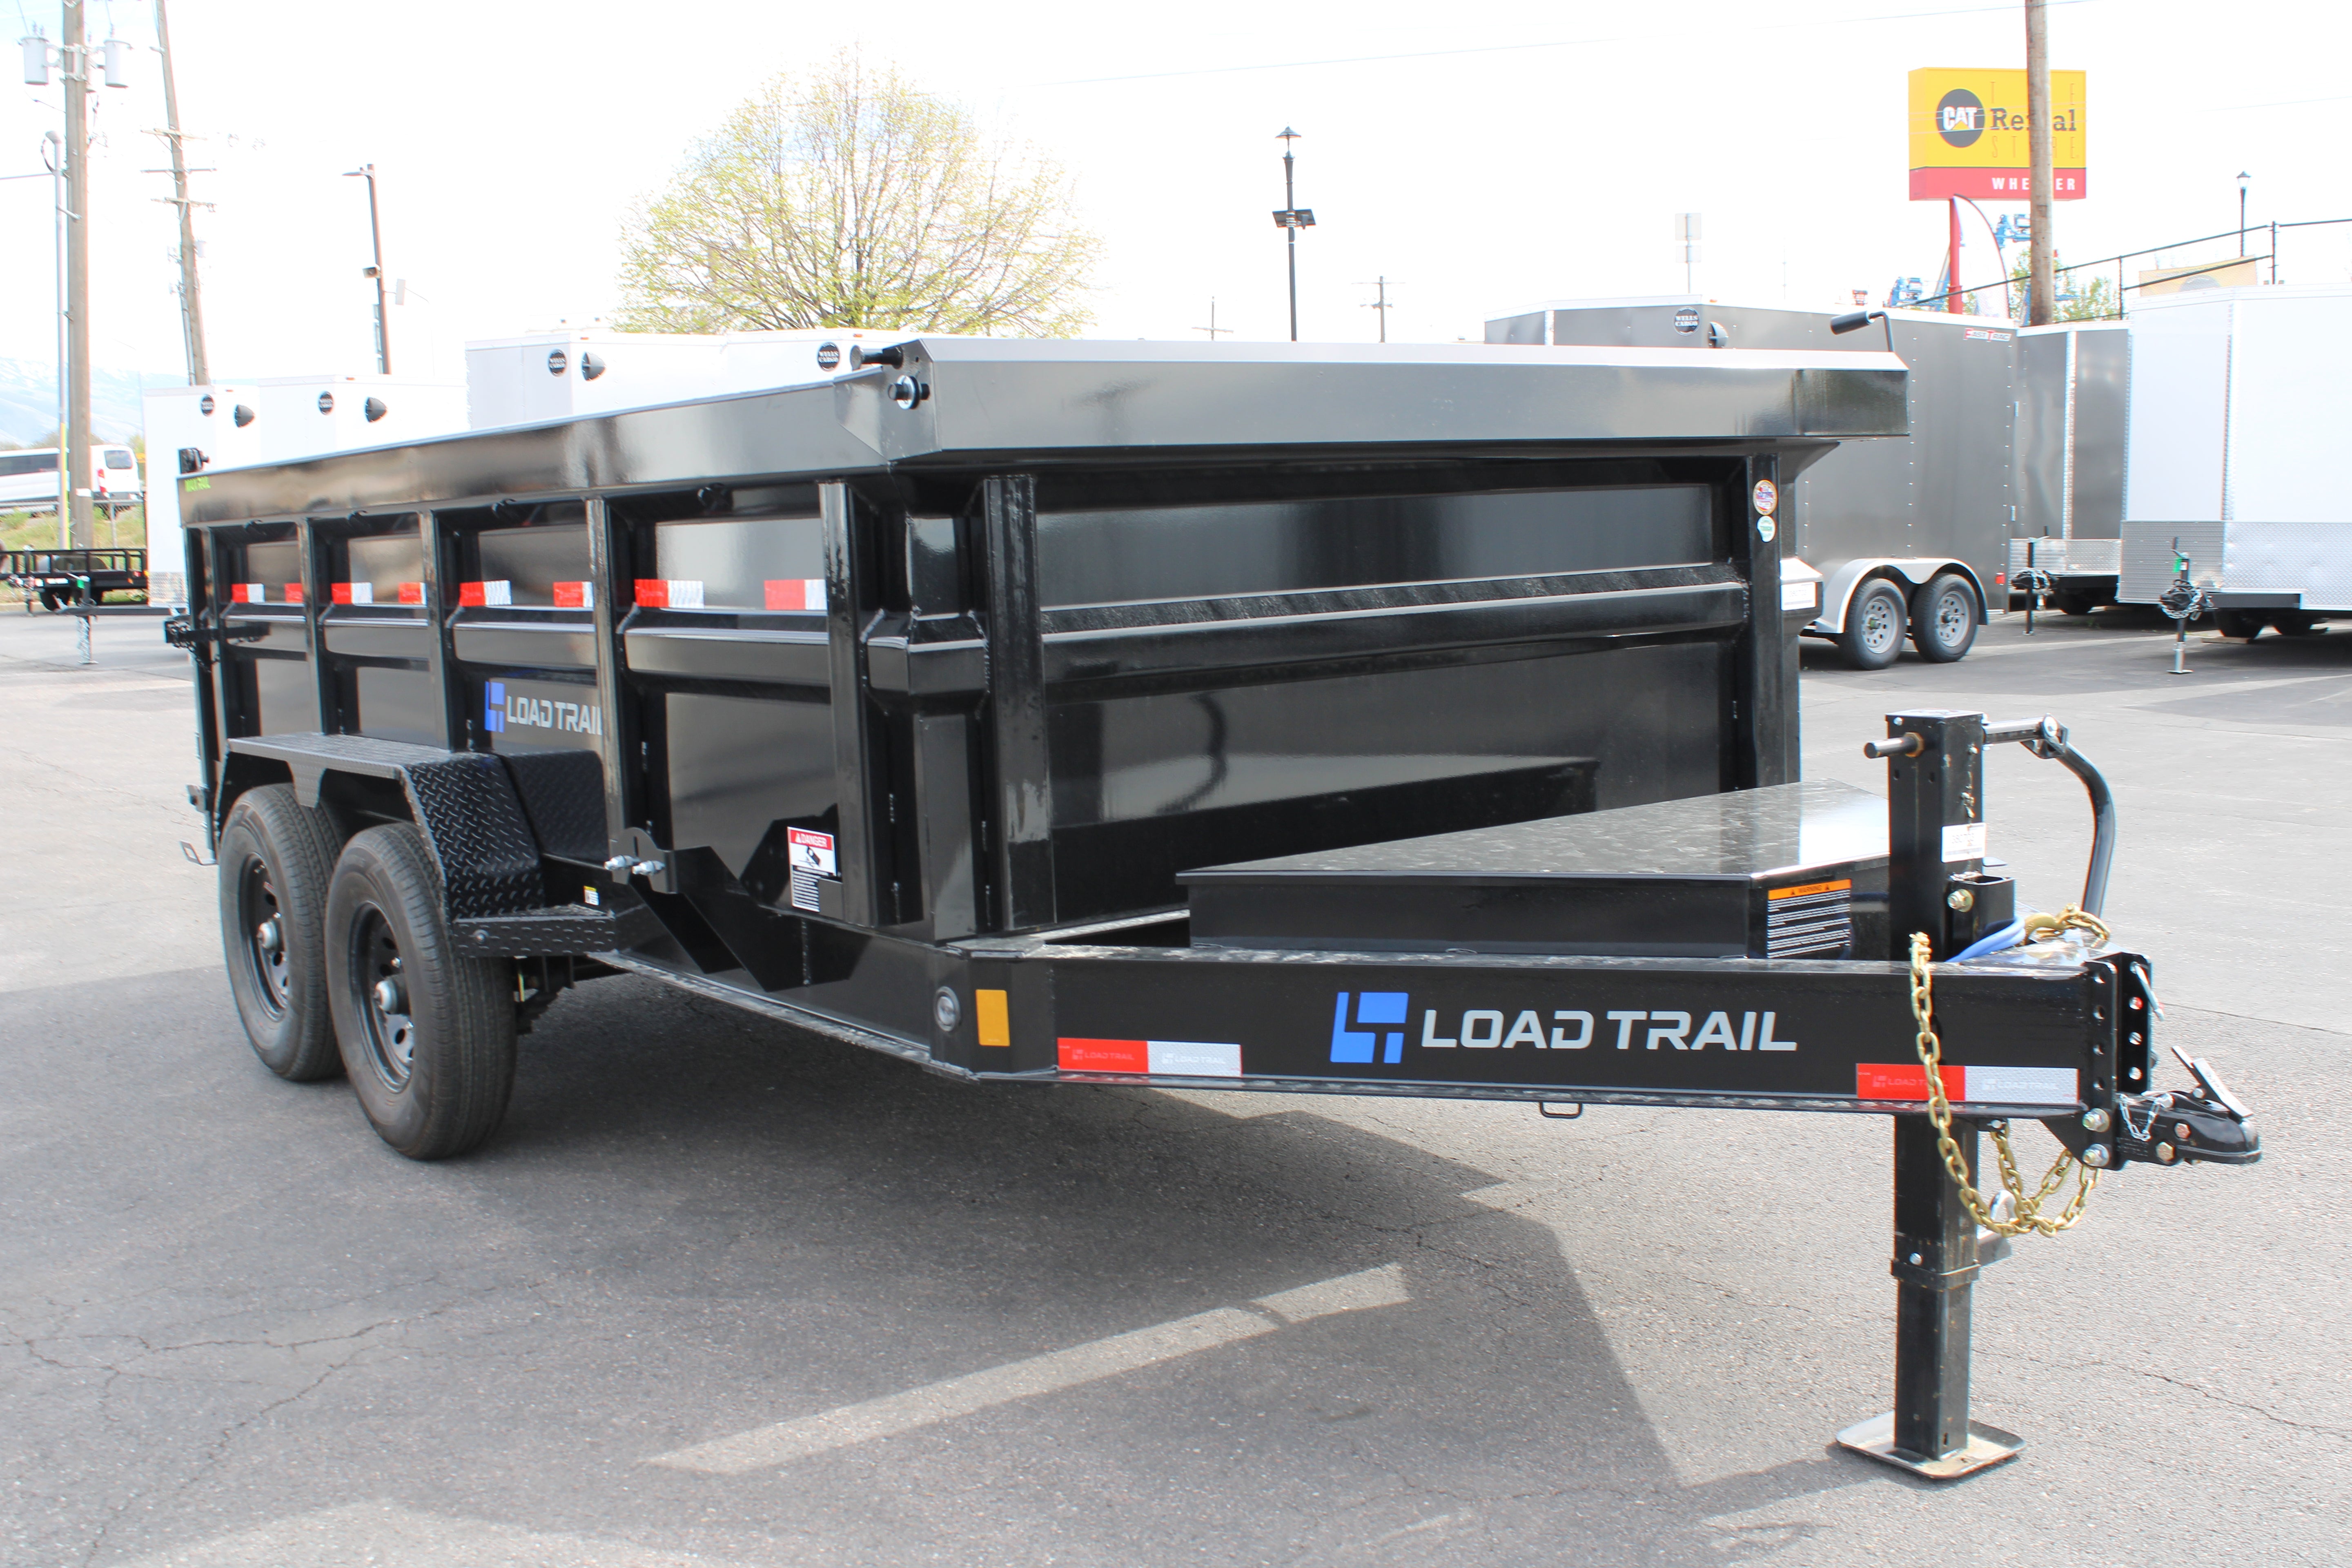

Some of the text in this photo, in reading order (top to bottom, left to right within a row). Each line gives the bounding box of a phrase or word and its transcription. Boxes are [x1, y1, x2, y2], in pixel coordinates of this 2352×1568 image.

[1990, 81, 2075, 105] TE
[1942, 106, 1978, 131] CAT
[1990, 107, 2076, 131] Real
[1992, 136, 2075, 158] STRE
[1991, 177, 2076, 190] WHEER
[506, 695, 553, 728] LOAD
[1421, 1009, 1797, 1051] LOAD TRAIL
[1109, 1052, 1134, 1060] TRAIL
